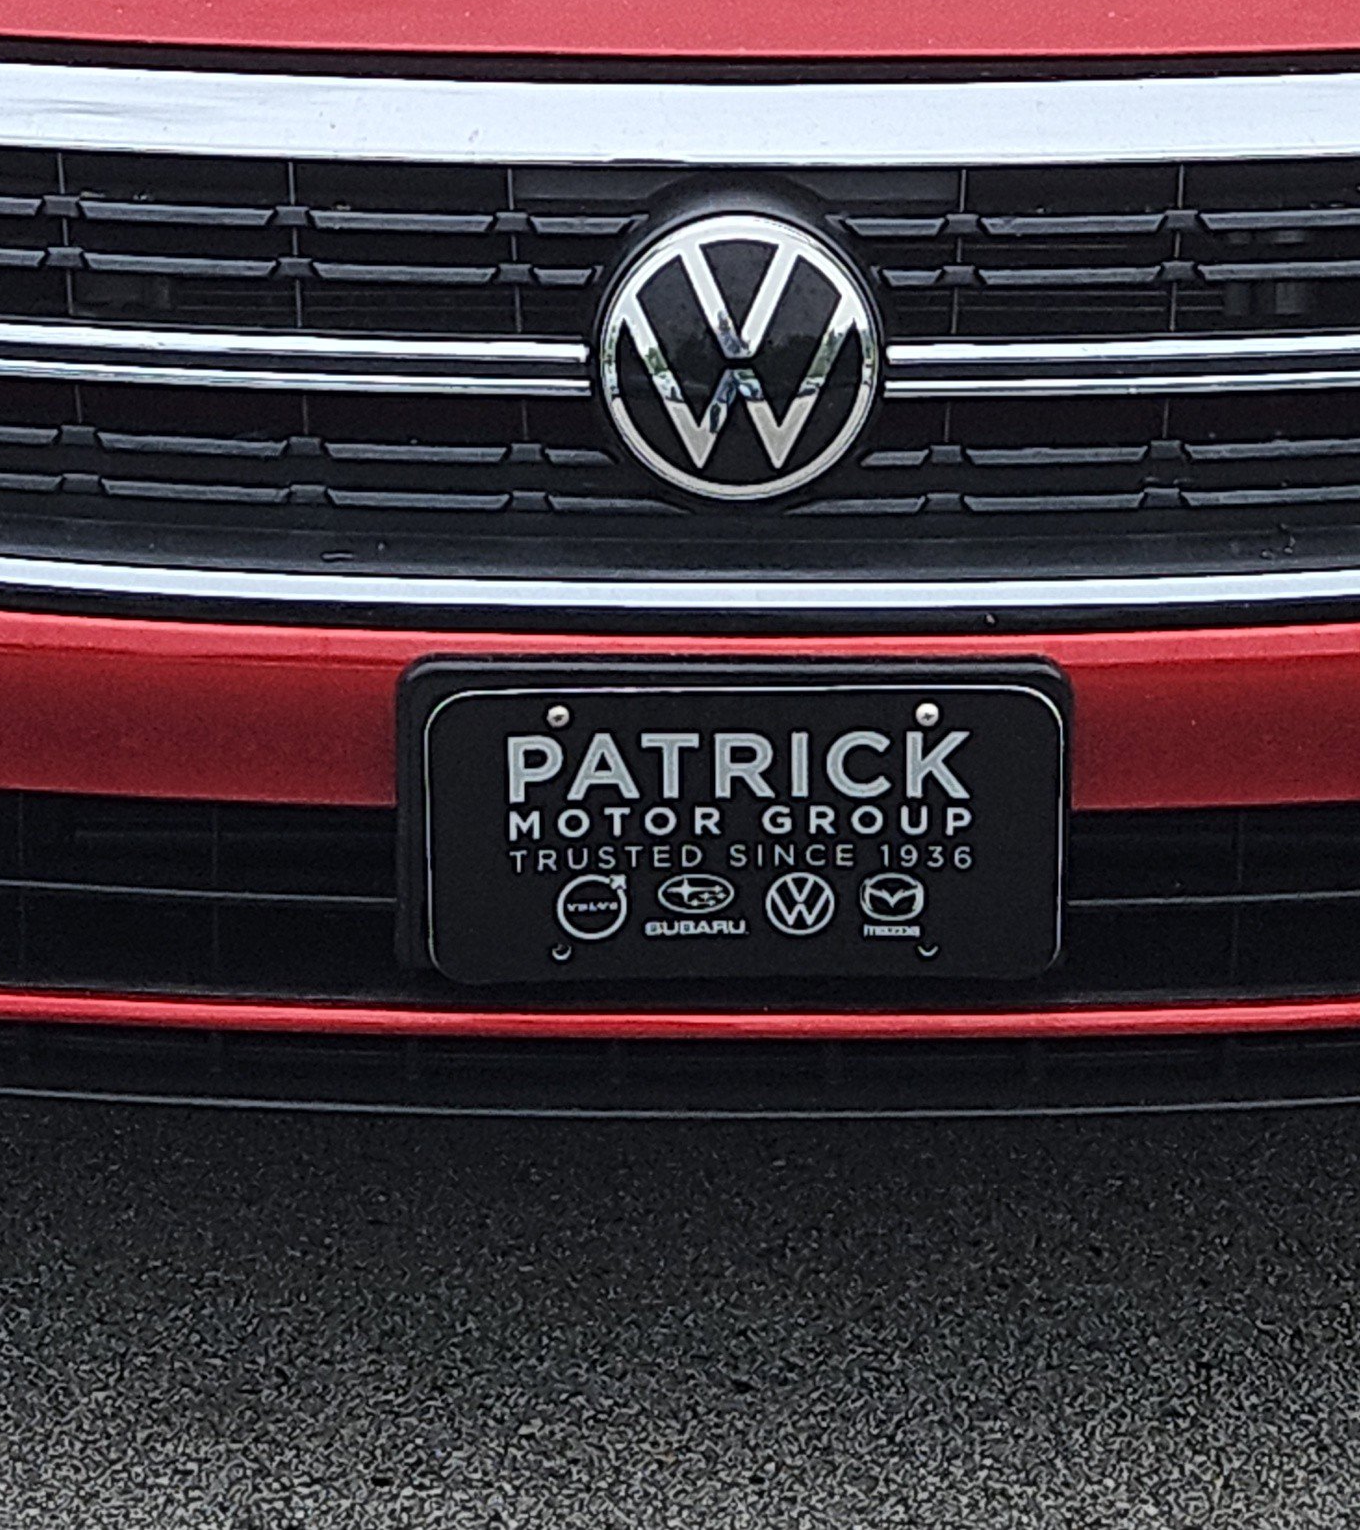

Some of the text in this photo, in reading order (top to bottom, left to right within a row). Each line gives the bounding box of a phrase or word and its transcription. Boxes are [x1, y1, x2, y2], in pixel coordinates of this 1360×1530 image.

[507, 731, 971, 804] PATRICK
[508, 805, 972, 841] MOTOR GROUP
[509, 843, 973, 872] TRUSTED SINCE 1936
[644, 920, 746, 936] SUBARU
